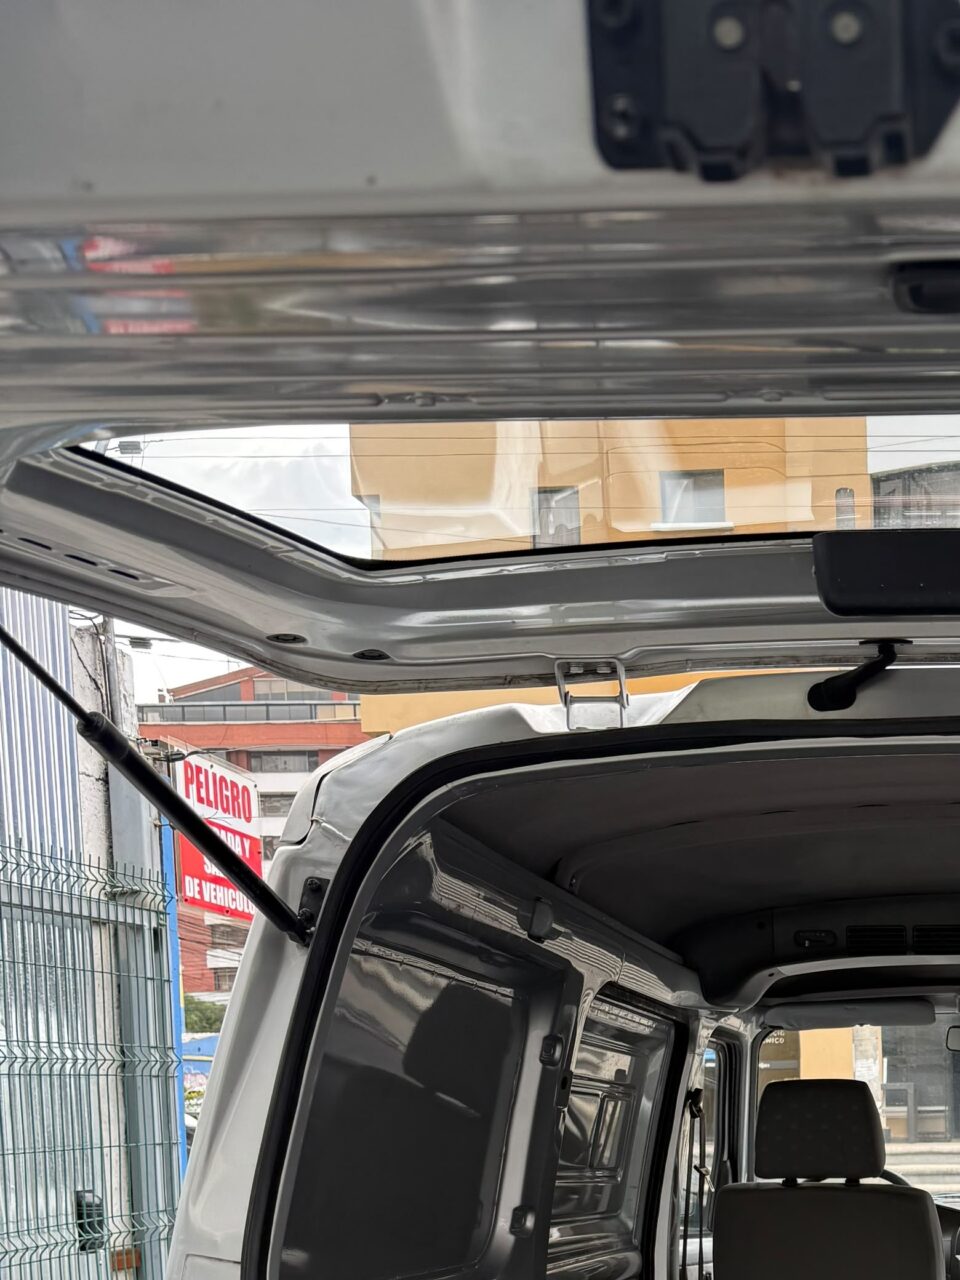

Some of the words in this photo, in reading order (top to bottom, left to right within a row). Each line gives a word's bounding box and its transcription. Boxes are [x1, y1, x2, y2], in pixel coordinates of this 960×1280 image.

[183, 760, 252, 823] PELIGRO
[242, 837, 250, 859] Y
[184, 874, 201, 900] DE
